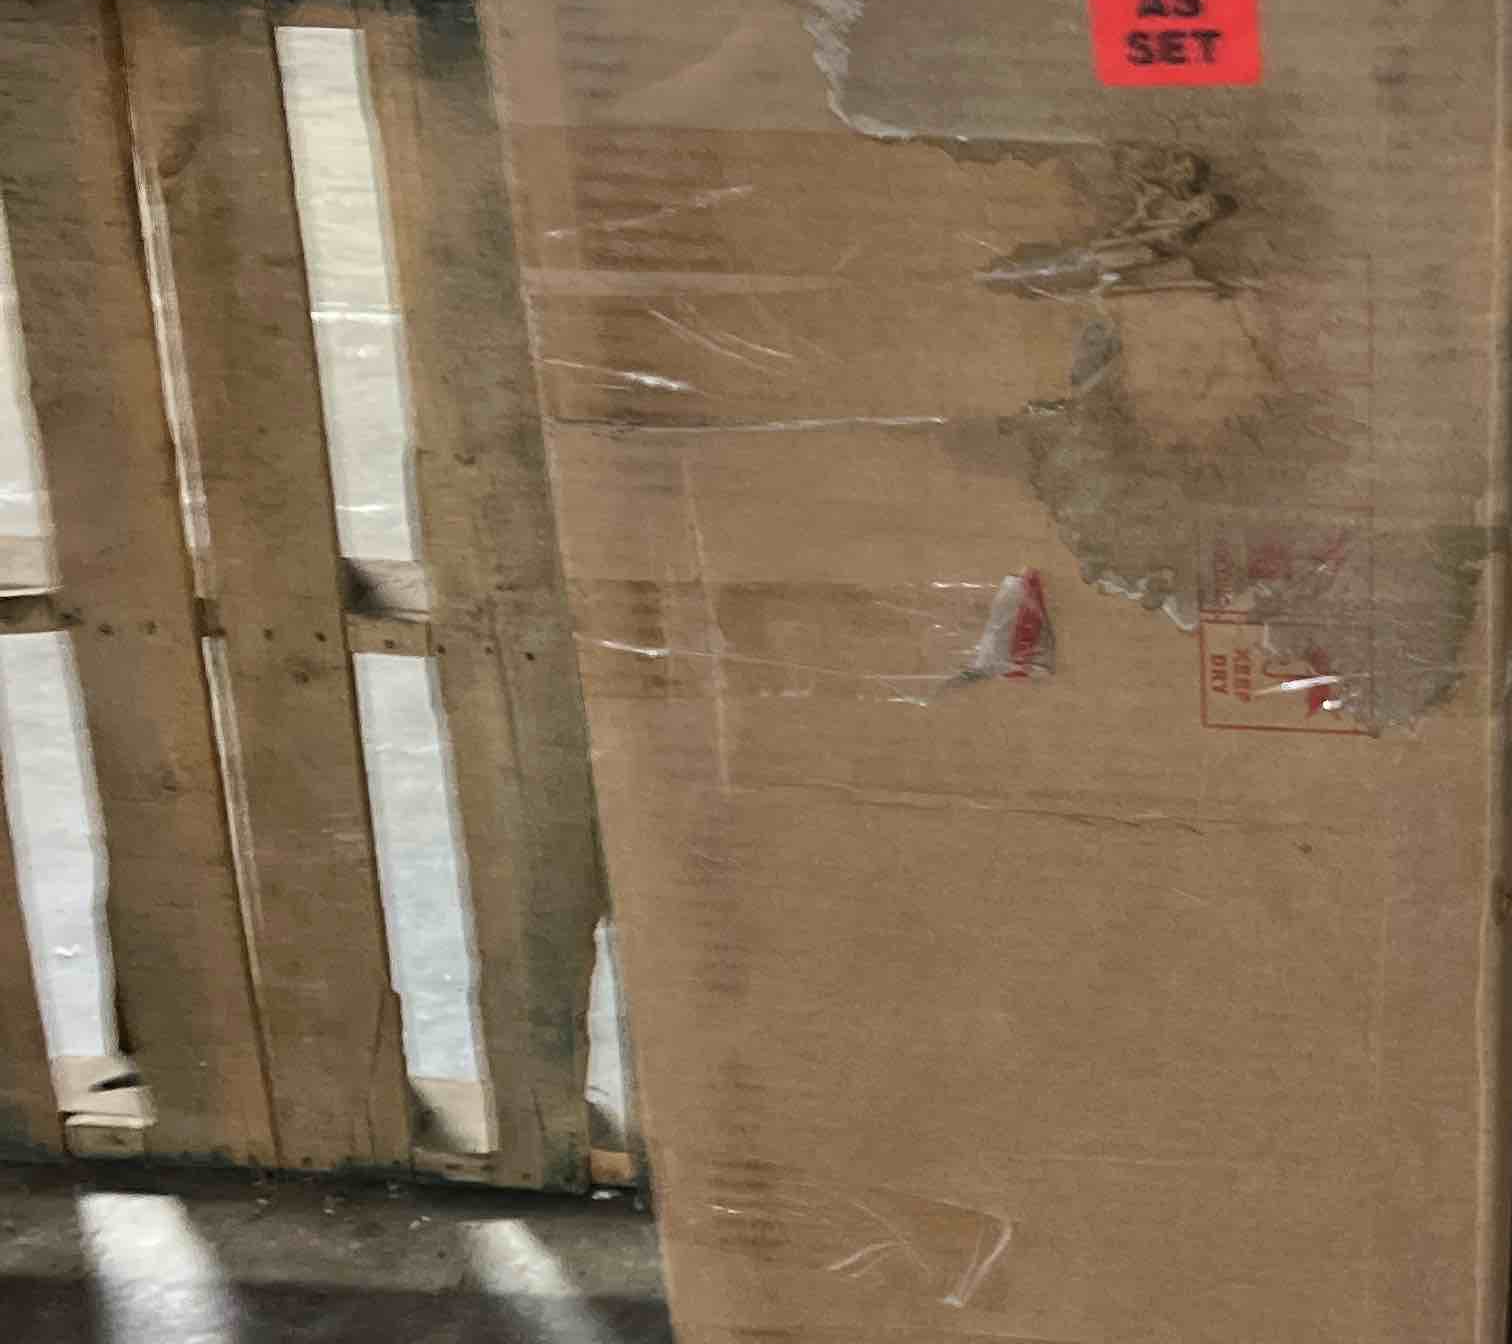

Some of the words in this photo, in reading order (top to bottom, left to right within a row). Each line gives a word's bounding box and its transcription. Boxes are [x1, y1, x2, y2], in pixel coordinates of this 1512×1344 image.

[1125, 29, 1222, 66] SET
[1210, 655, 1229, 696] DRY
[1232, 647, 1252, 704] KEEP
